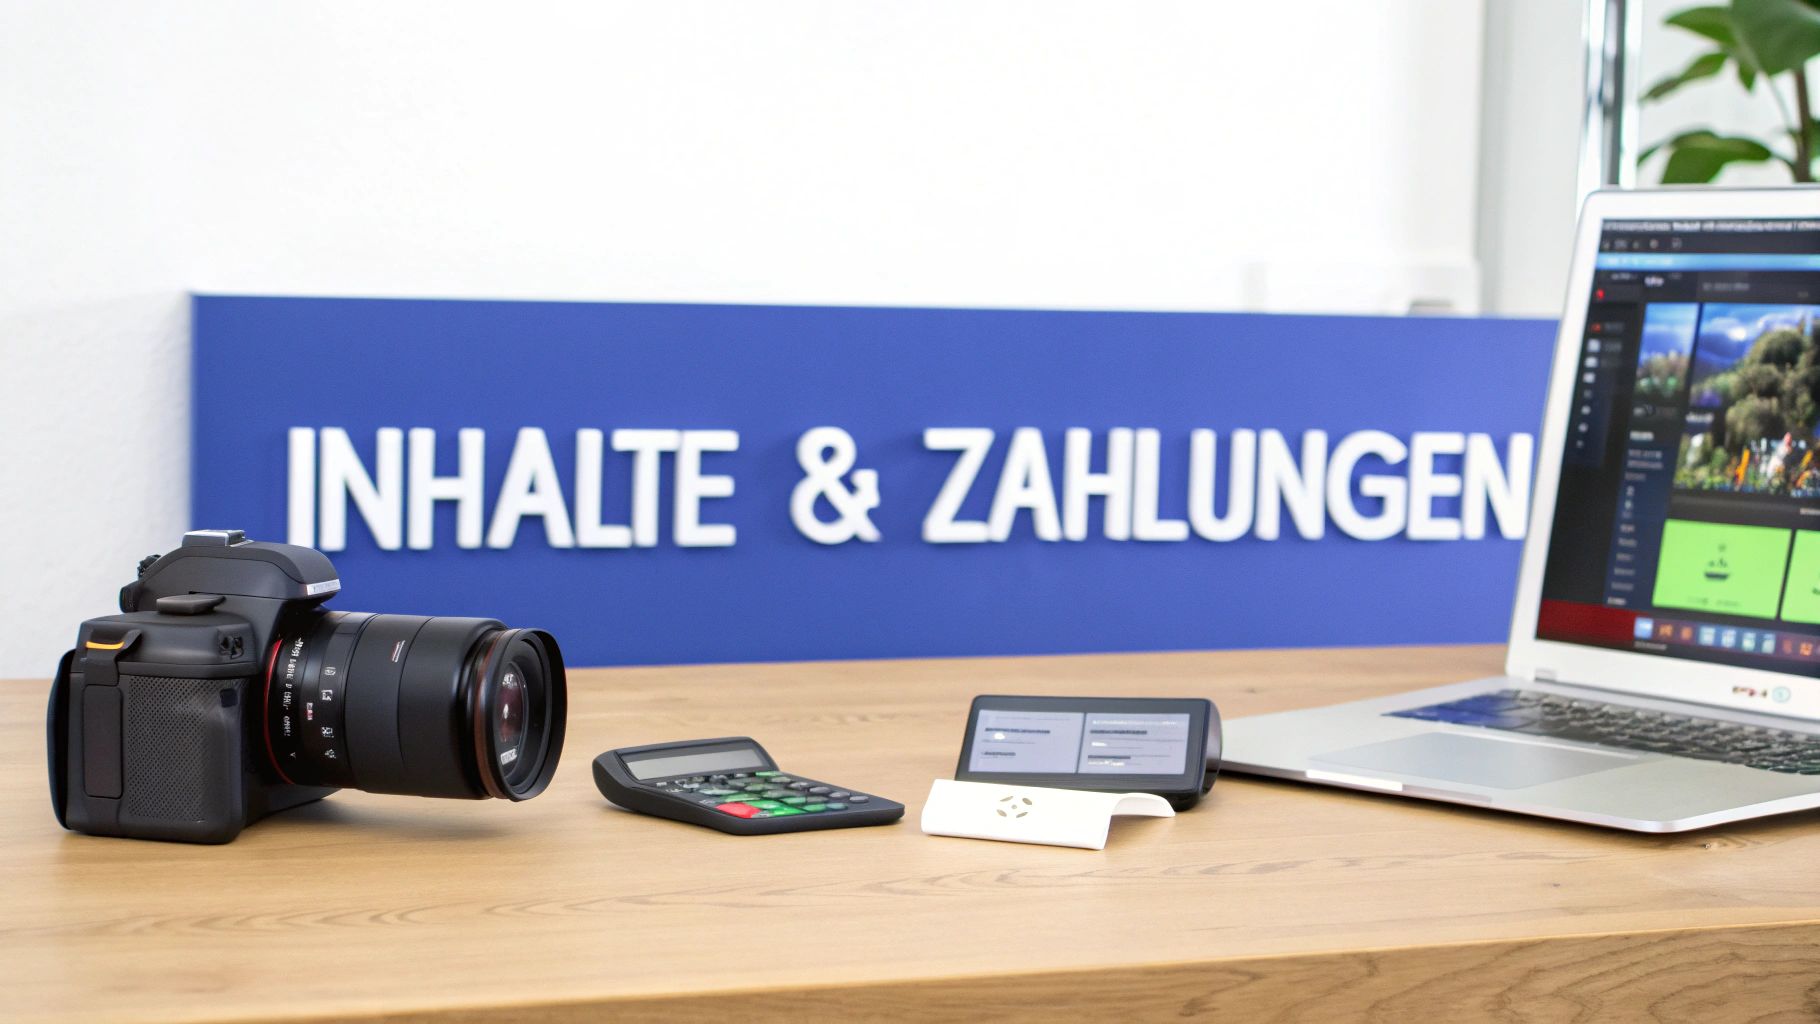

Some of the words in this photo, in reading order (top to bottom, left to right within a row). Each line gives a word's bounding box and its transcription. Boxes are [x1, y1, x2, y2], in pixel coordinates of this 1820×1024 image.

[287, 426, 739, 551] INHALTE
[790, 426, 882, 545] &
[922, 427, 1534, 543] ZAHLUNGEN
